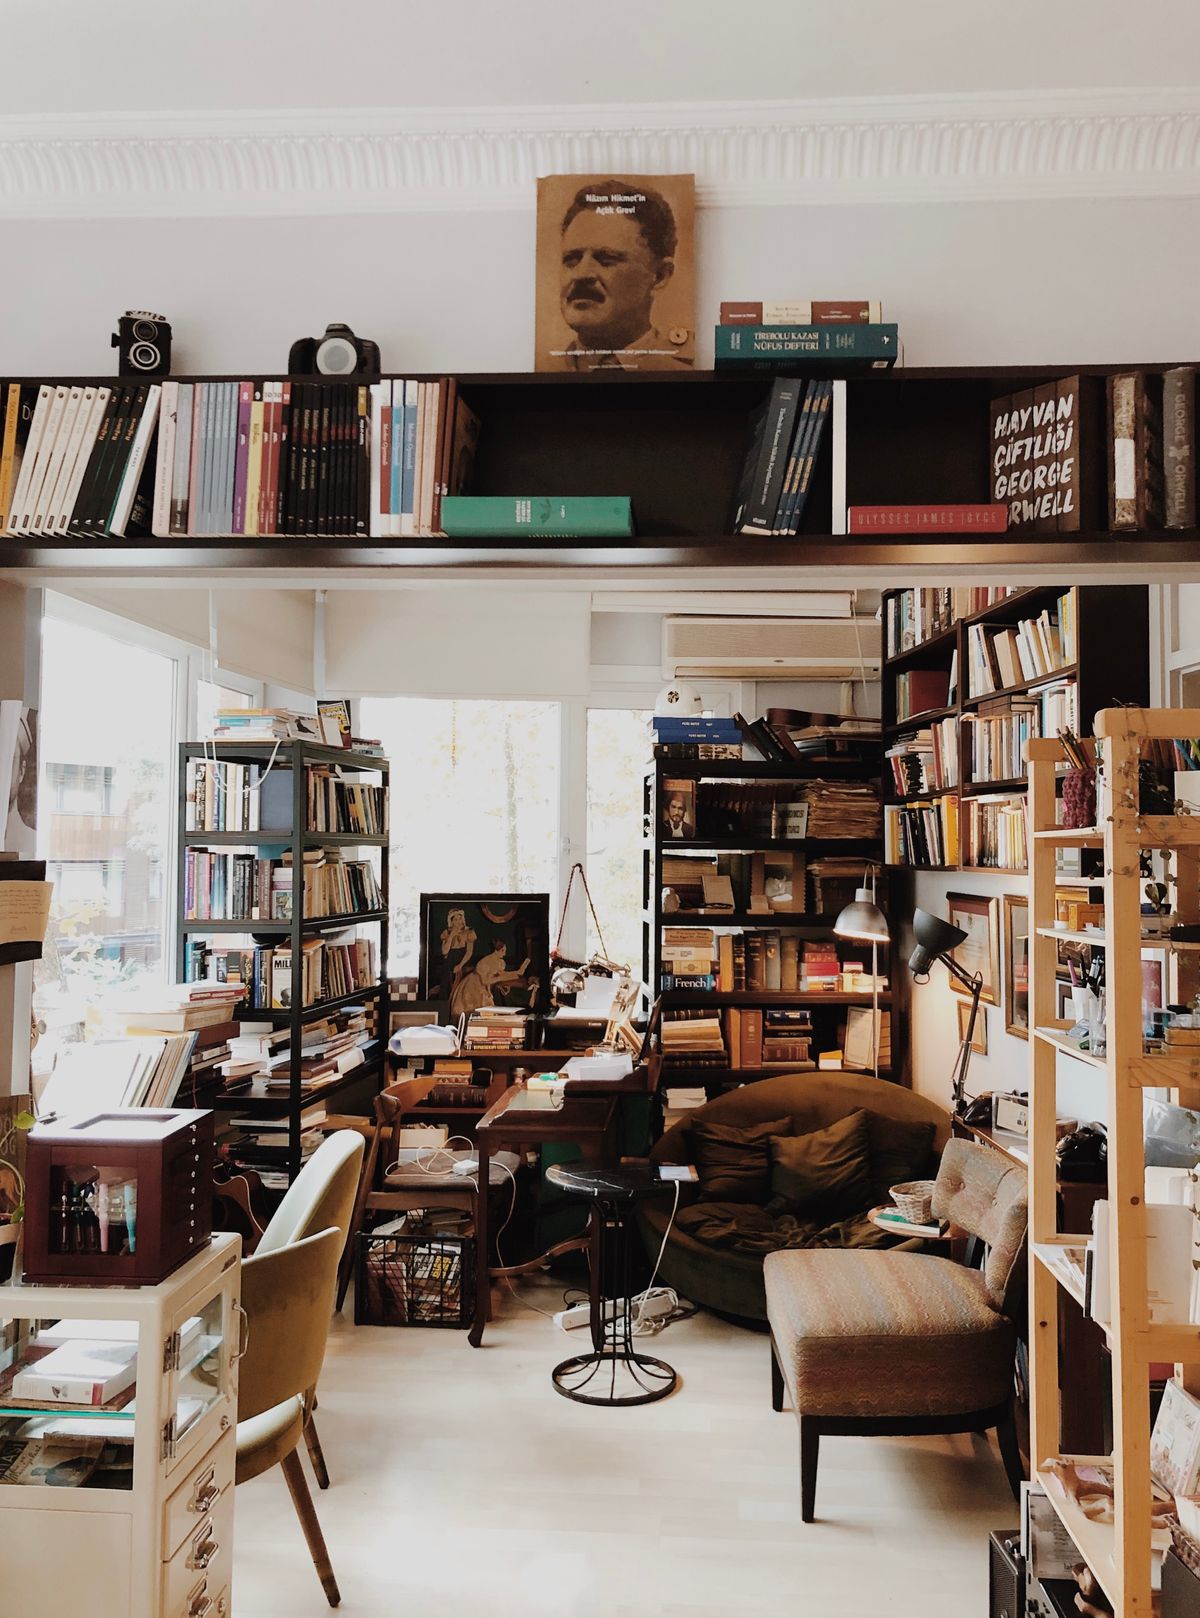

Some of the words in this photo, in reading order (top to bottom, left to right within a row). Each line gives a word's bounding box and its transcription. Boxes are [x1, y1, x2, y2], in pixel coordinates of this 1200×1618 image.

[611, 193, 646, 202] Hikmet'in
[754, 332, 789, 340] TİREBOLU
[754, 341, 783, 350] NÜFUS
[786, 341, 819, 350] DEFTERİ
[994, 393, 1074, 440] HAYVAN
[1174, 394, 1186, 442] GEORGE
[994, 420, 1074, 476] ÇİFTLİĞİ
[994, 457, 1074, 500] GEORGE
[1174, 464, 1186, 513] ORWELL
[858, 512, 909, 525] ULYSSES
[916, 511, 954, 526] JAMES
[961, 511, 997, 526] JOYCE
[1008, 488, 1074, 526] RWELL
[675, 977, 706, 987] French
